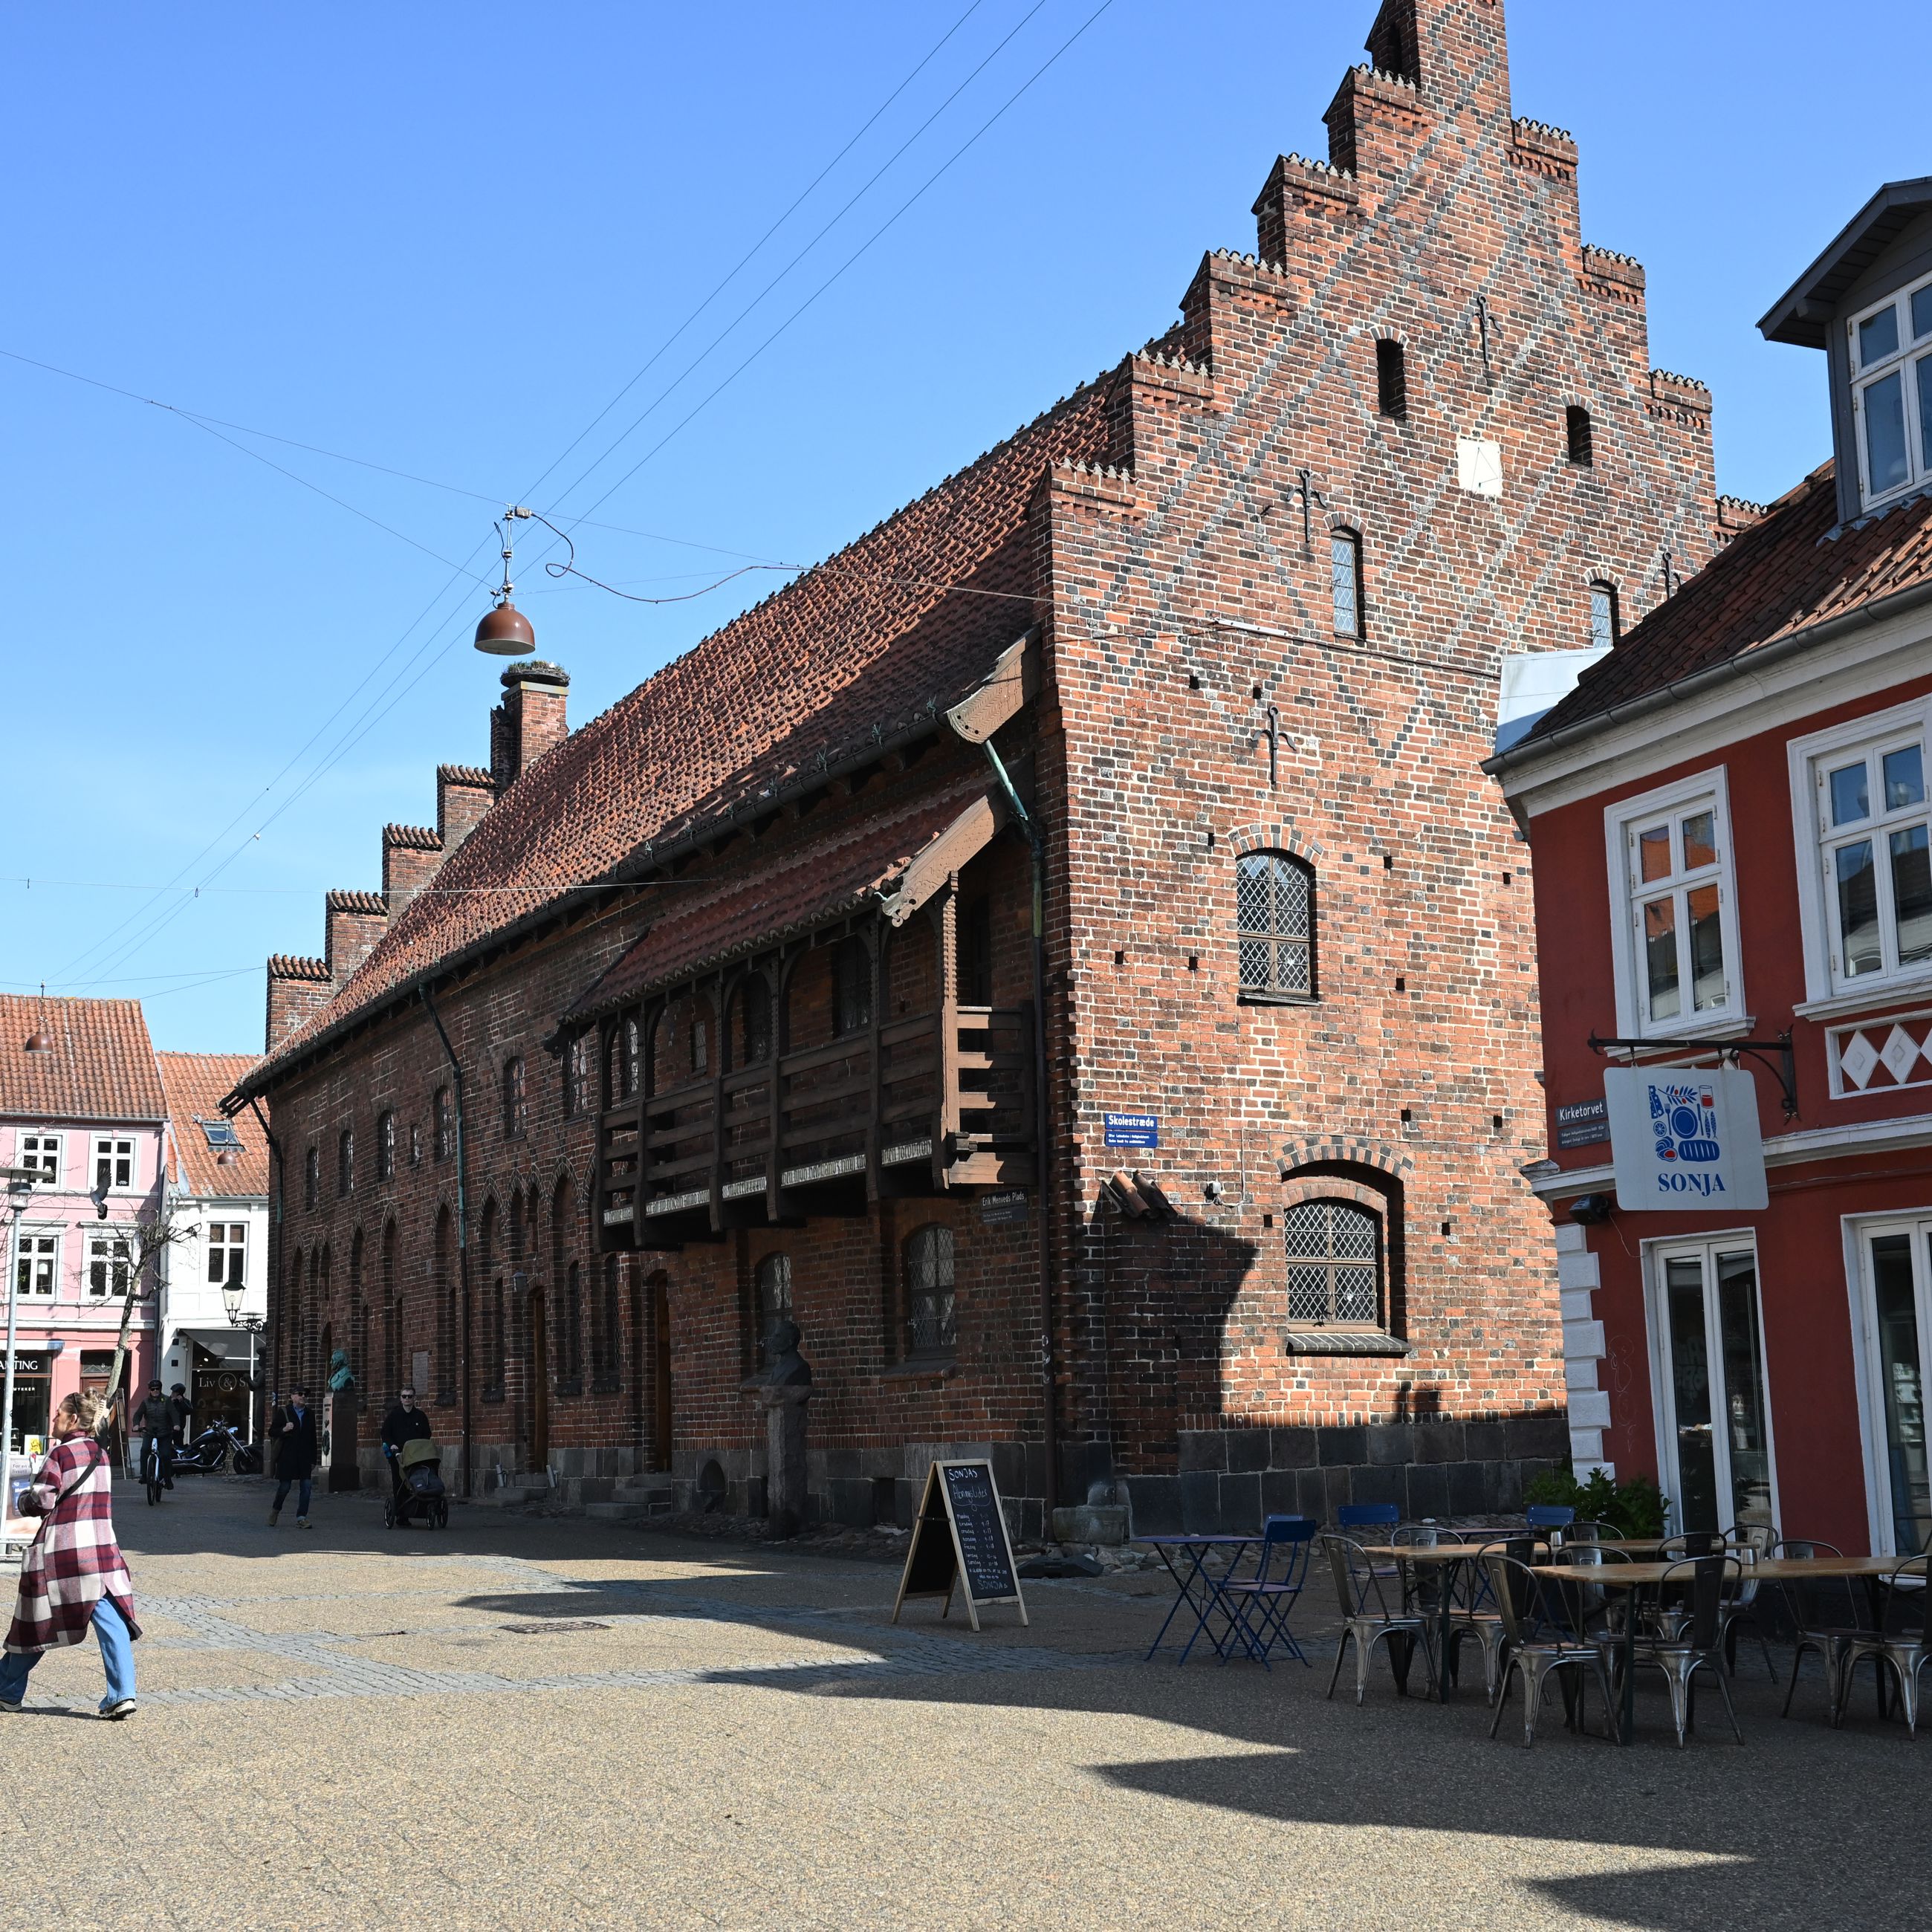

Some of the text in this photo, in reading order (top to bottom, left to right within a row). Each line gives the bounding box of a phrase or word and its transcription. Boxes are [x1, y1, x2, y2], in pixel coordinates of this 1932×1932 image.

[1560, 1101, 1604, 1121] Kirketorvet
[1108, 1115, 1155, 1127] Skolestræde
[1658, 1173, 1726, 1197] SONJA
[982, 1197, 991, 1207] Erik
[1012, 1191, 1025, 1202] Plads
[0, 1361, 38, 1370] ATING
[198, 1377, 215, 1387] Liv
[948, 1468, 978, 1481] SONJAS
